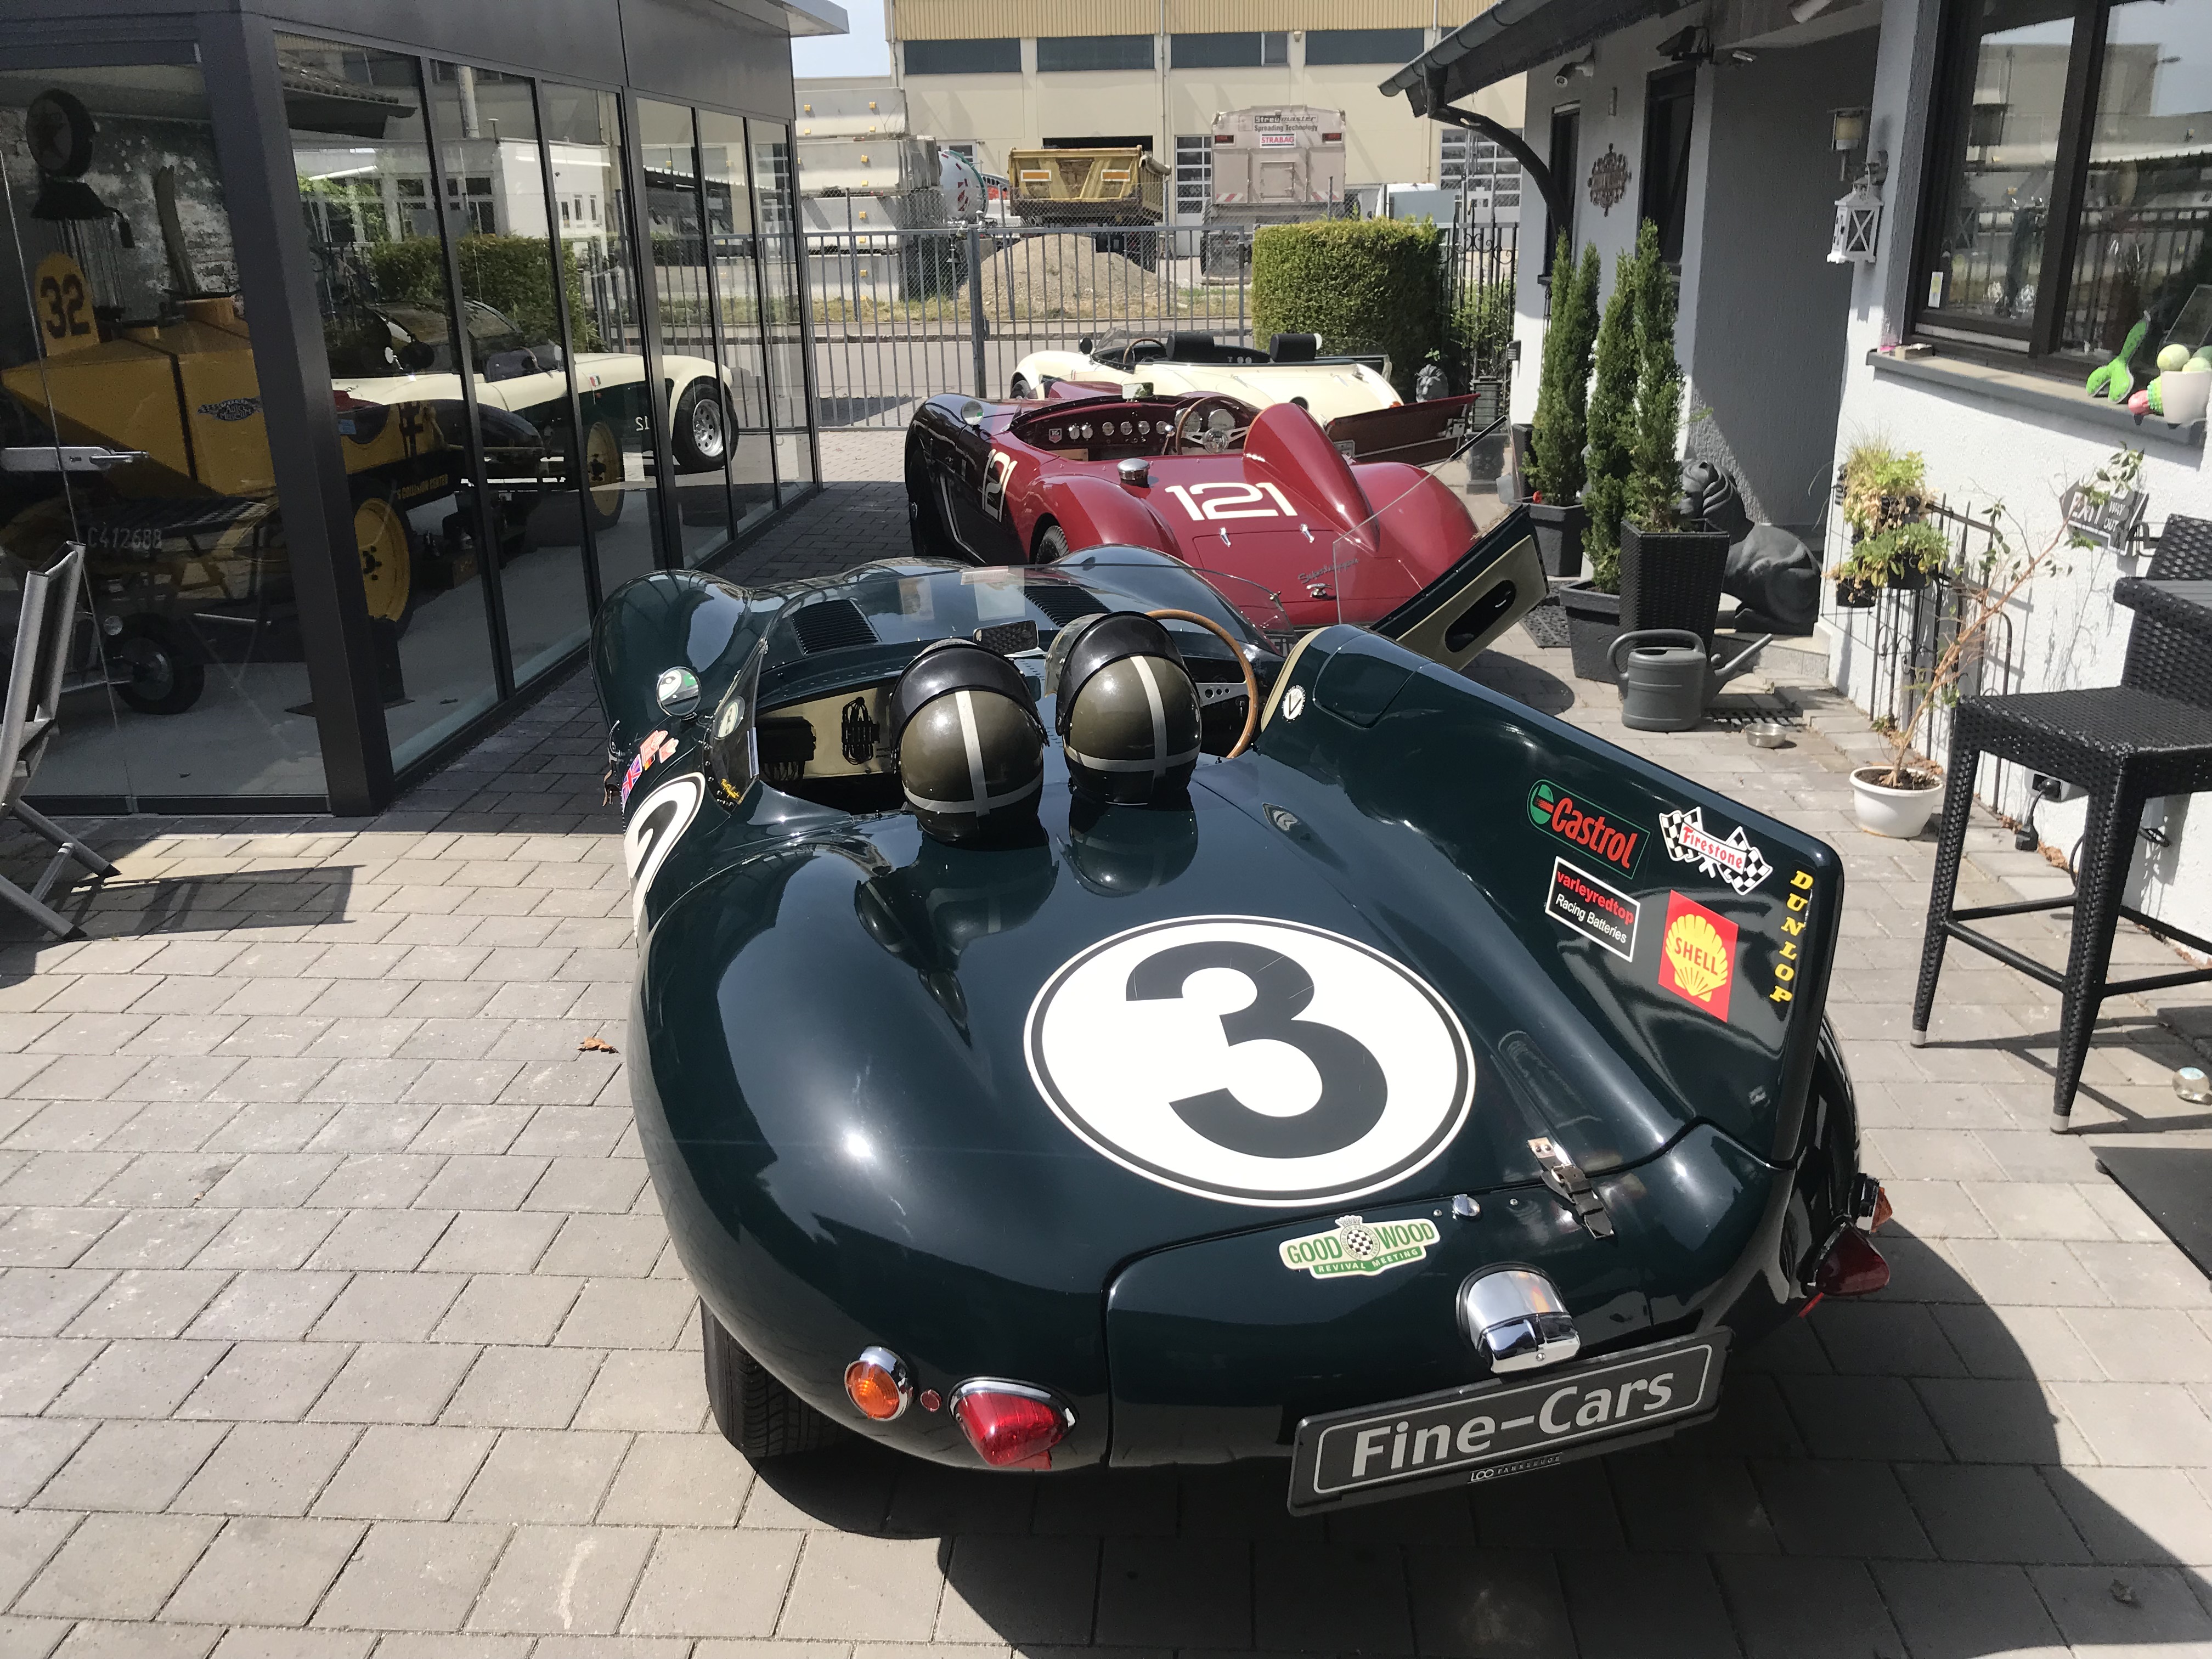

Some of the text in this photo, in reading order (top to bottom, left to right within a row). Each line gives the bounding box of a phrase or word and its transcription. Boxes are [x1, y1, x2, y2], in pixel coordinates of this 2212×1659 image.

[40, 274, 91, 339] 32
[982, 448, 1018, 522] 121
[1165, 482, 1298, 521] 121
[2108, 501, 2126, 516] WAY
[2103, 517, 2119, 532] OUT
[1552, 798, 1638, 869] Castrol
[1681, 826, 1743, 869] Firestone
[1555, 893, 1627, 944] Racing Batteries
[1556, 871, 1634, 926] varleyredtop
[1674, 936, 1718, 976] SHELL
[1769, 870, 1813, 1003] DUNLOP
[1126, 940, 1389, 1159] 3
[1287, 1222, 1435, 1264] GOOD WOOD
[1318, 1249, 1418, 1273] REVIVAL MEETING
[1352, 1372, 1674, 1478] Fine-Cars
